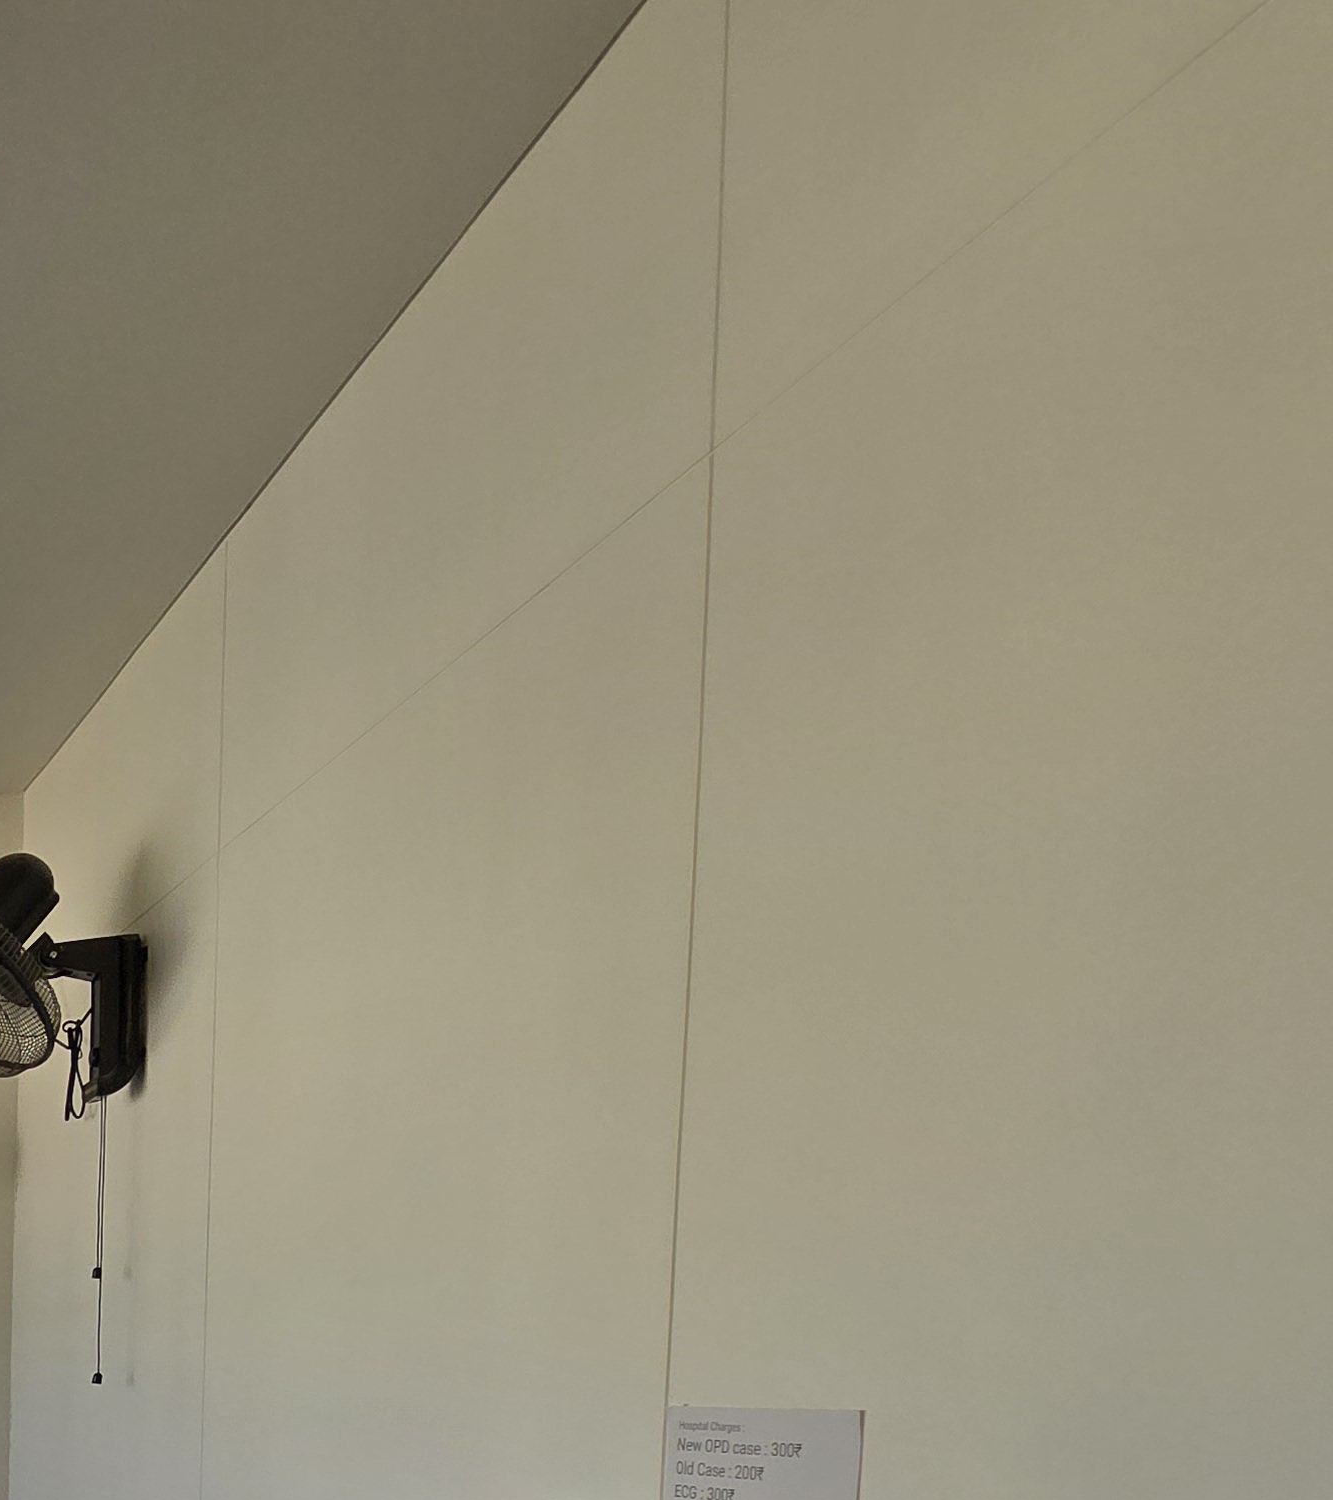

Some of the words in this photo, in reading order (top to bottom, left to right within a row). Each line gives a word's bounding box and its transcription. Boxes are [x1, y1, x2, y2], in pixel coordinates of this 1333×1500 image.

[679, 1421, 708, 1433] Hospital
[677, 1438, 702, 1452] New
[705, 1439, 729, 1454] OPD
[733, 1443, 761, 1456] case
[771, 1442, 803, 1458] 300₹
[676, 1460, 694, 1475] Old
[697, 1462, 726, 1478] Case
[734, 1465, 764, 1481] 200₹
[674, 1484, 697, 1499] ECG
